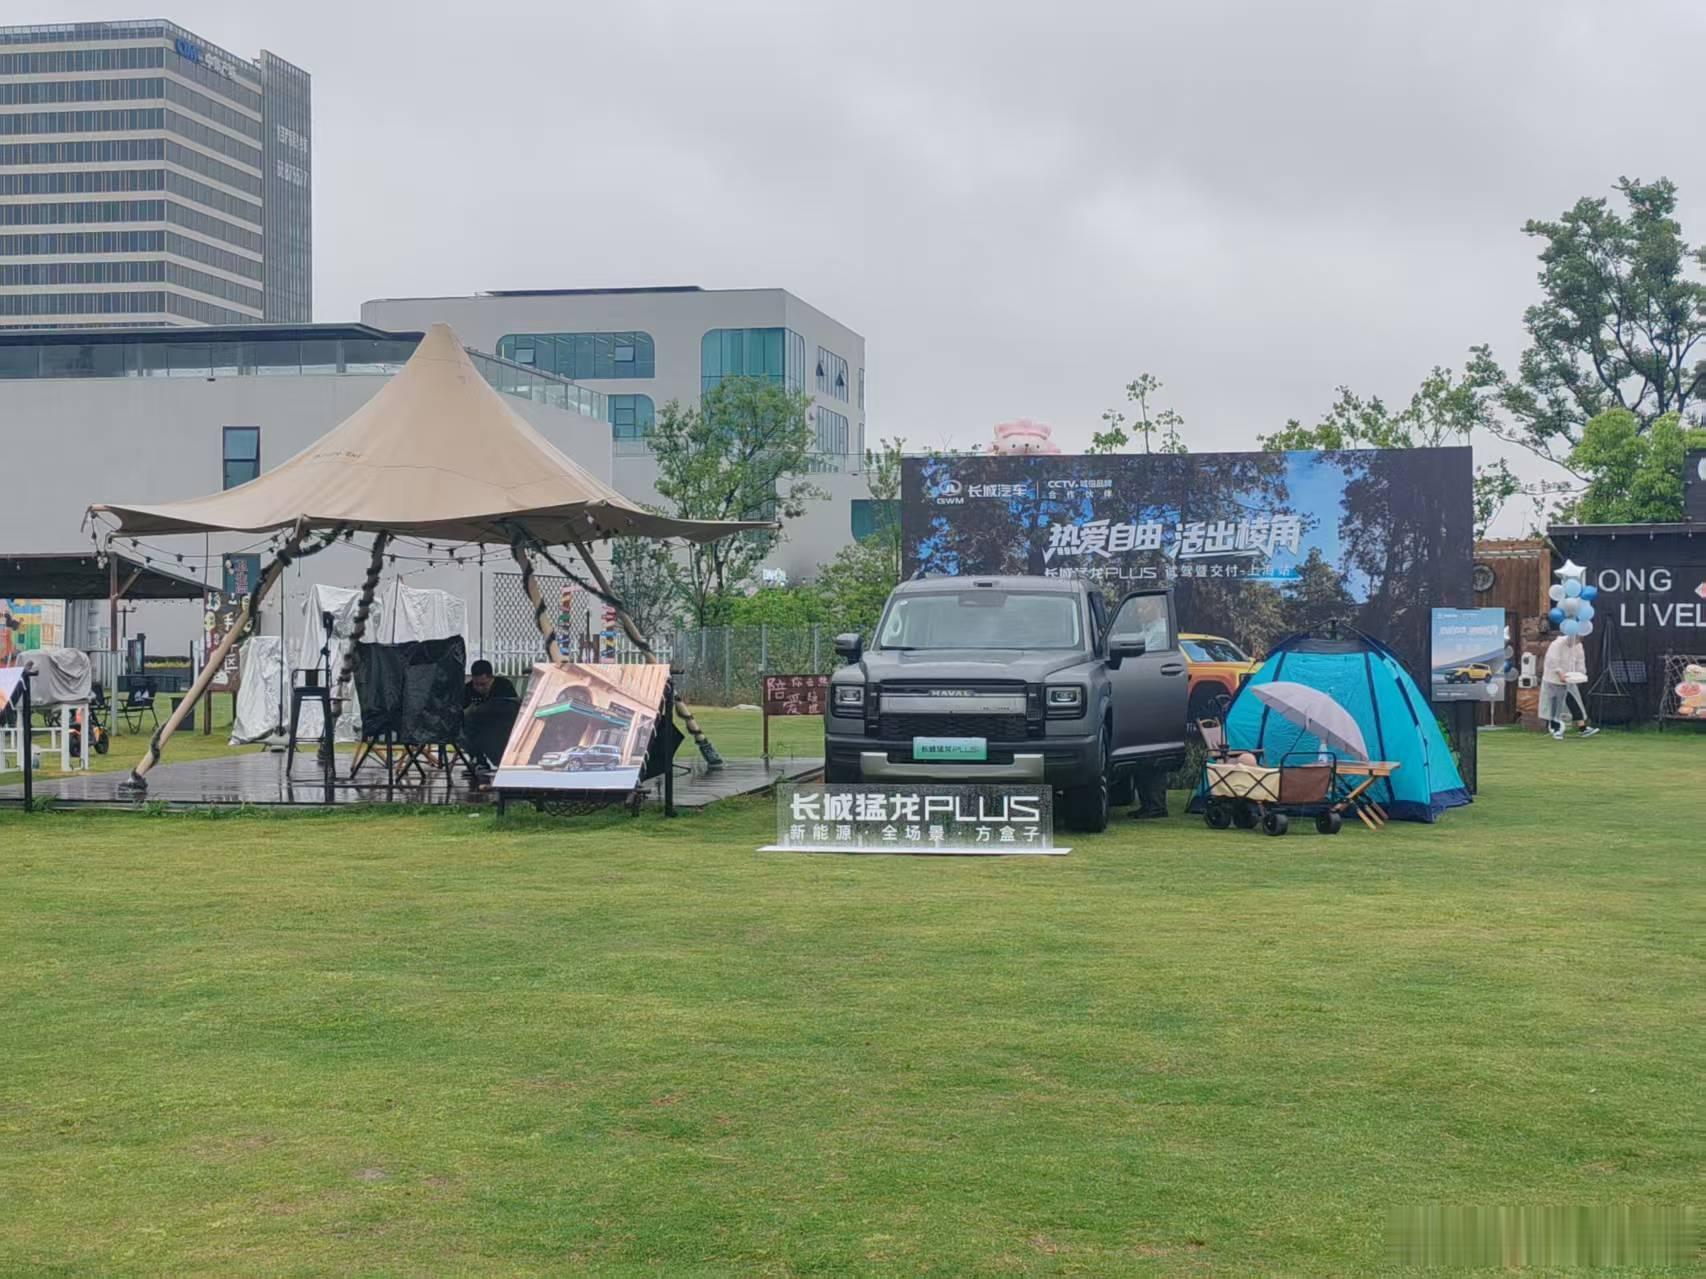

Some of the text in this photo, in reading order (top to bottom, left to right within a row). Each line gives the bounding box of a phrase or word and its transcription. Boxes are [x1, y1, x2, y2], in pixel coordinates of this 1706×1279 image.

[936, 497, 965, 505] GWM
[968, 484, 1027, 497] 长城汽车
[1043, 514, 1300, 564] 热爱自由 活出棱角
[790, 793, 1040, 822] 长城猛龙PLUS
